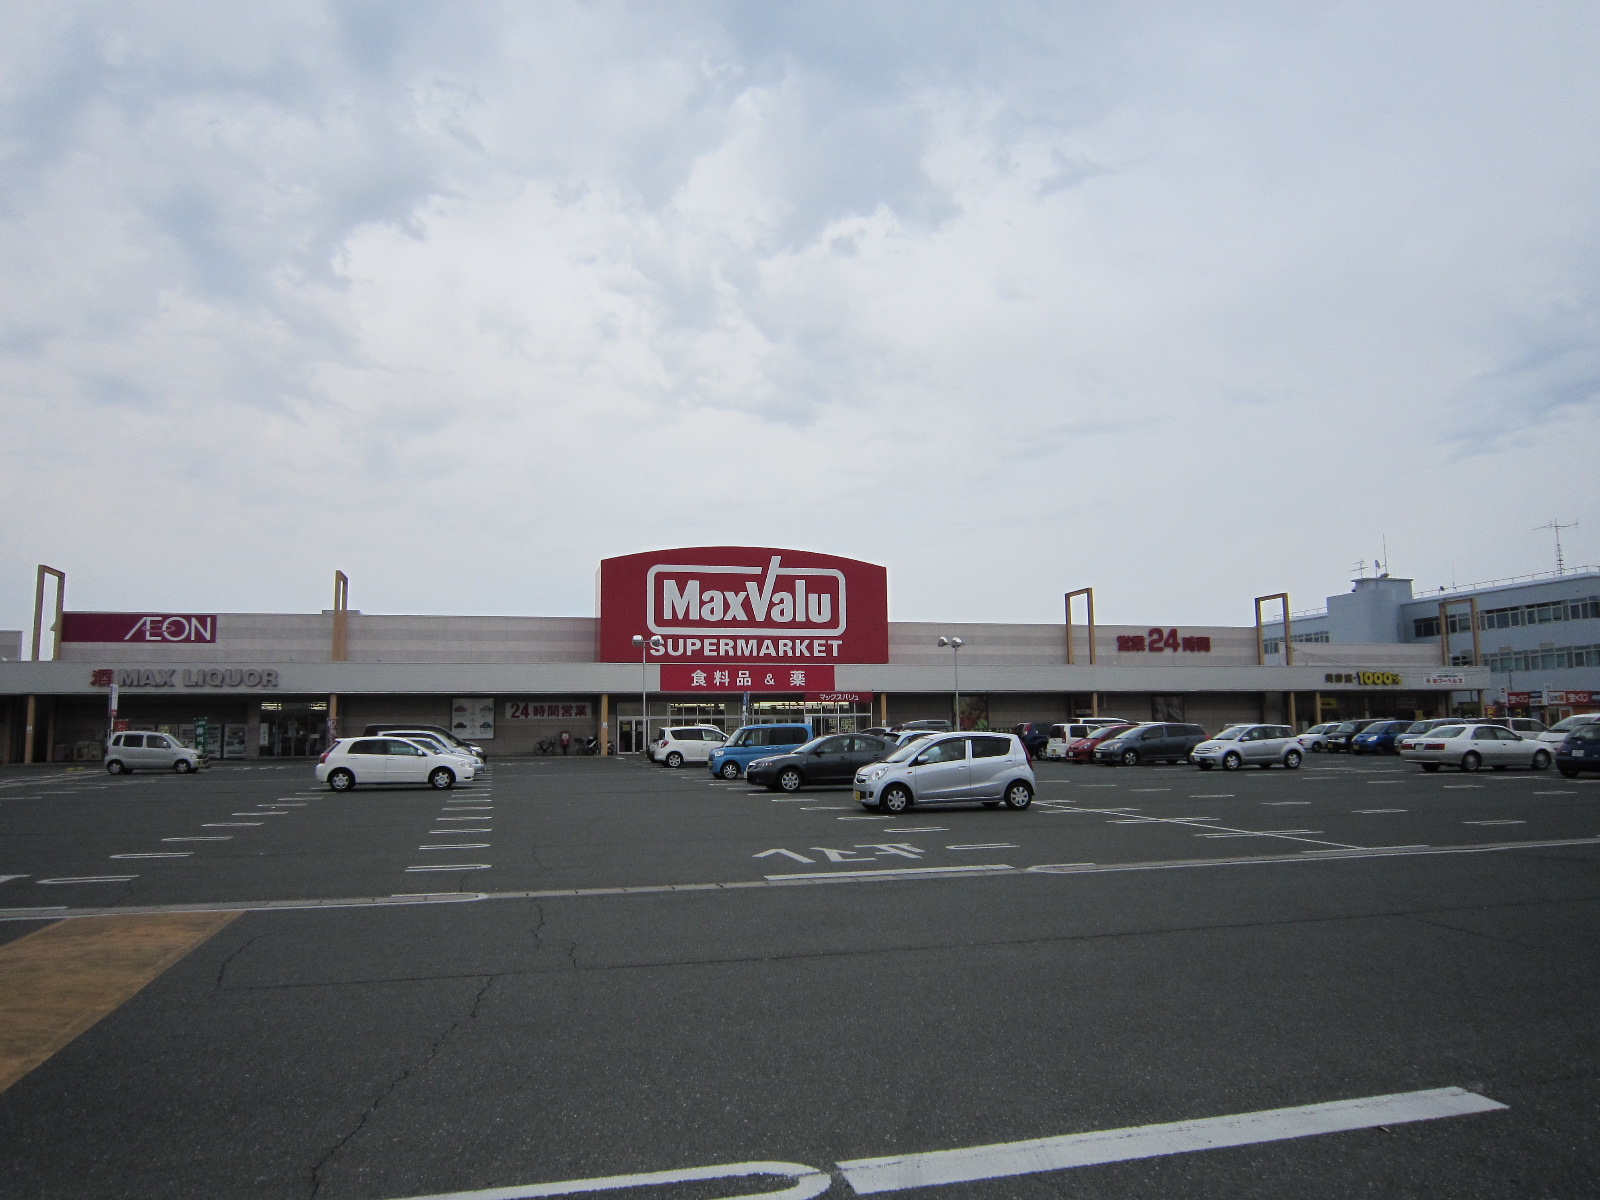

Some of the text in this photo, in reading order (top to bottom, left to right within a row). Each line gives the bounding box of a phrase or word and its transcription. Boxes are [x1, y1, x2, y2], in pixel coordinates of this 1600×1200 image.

[663, 556, 833, 624] MaxValu
[649, 638, 843, 657] SUPERMARKET
[117, 668, 280, 688] MAX LIQUOR
[690, 669, 752, 687] 食料品
[764, 673, 776, 686] &
[510, 702, 588, 719] 24時間営業
